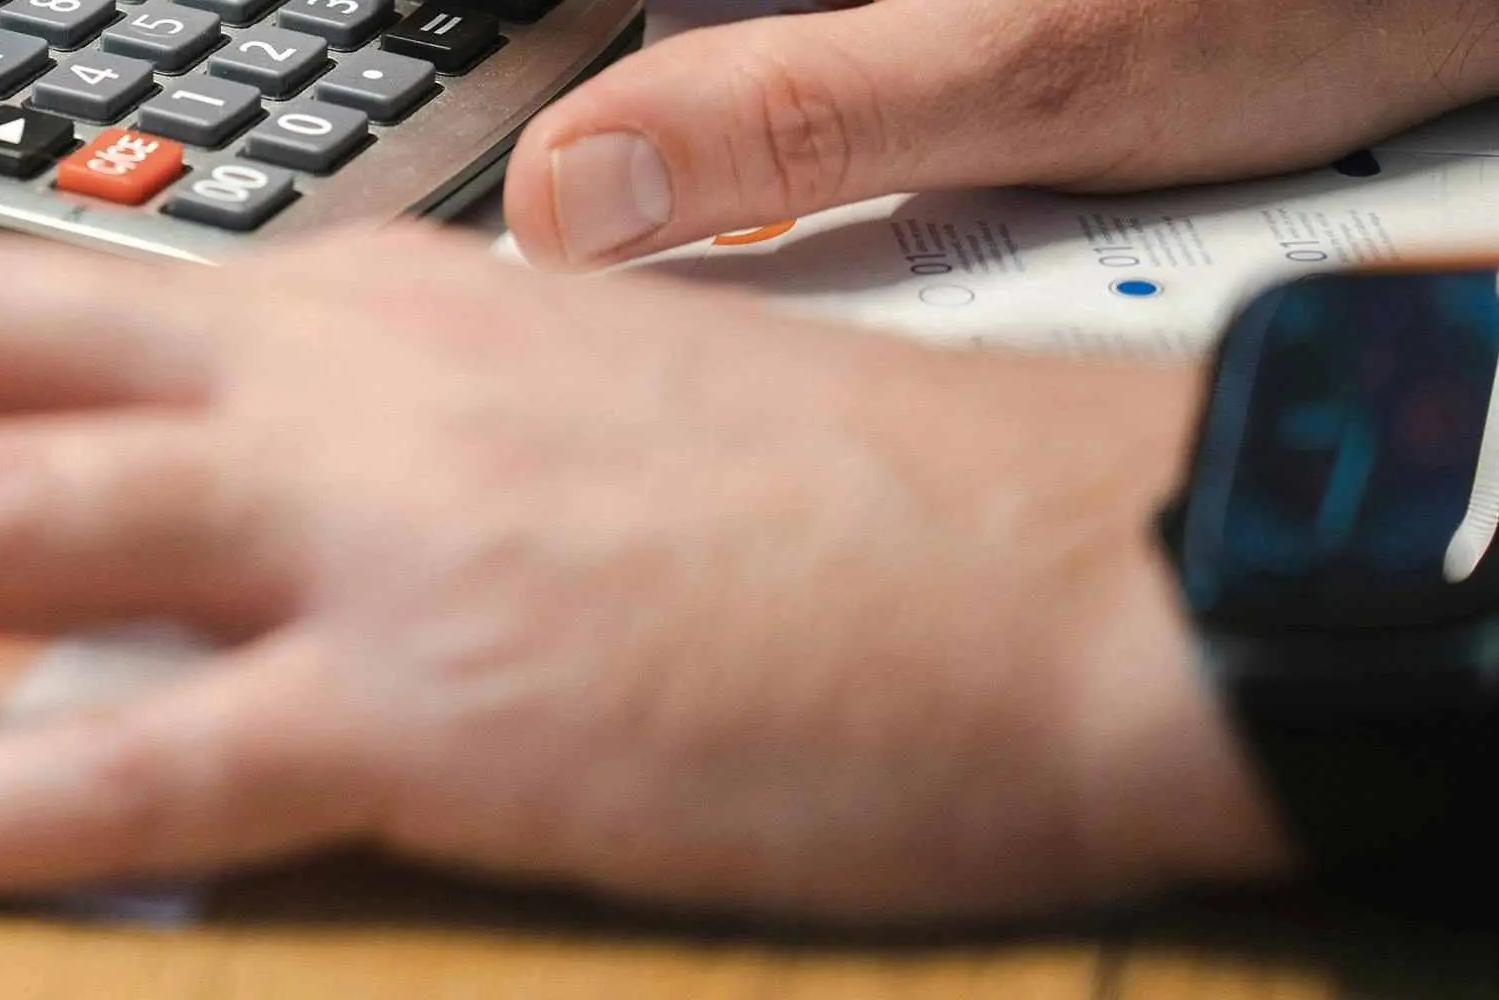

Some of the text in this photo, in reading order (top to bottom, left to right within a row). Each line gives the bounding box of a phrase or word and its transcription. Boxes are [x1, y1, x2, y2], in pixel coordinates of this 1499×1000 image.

[130, 13, 185, 35] 5
[419, 12, 463, 36] =
[238, 39, 298, 63] 2
[69, 63, 121, 86] 4
[171, 89, 226, 107] 1
[276, 112, 334, 136] 0
[192, 164, 269, 202] 00
